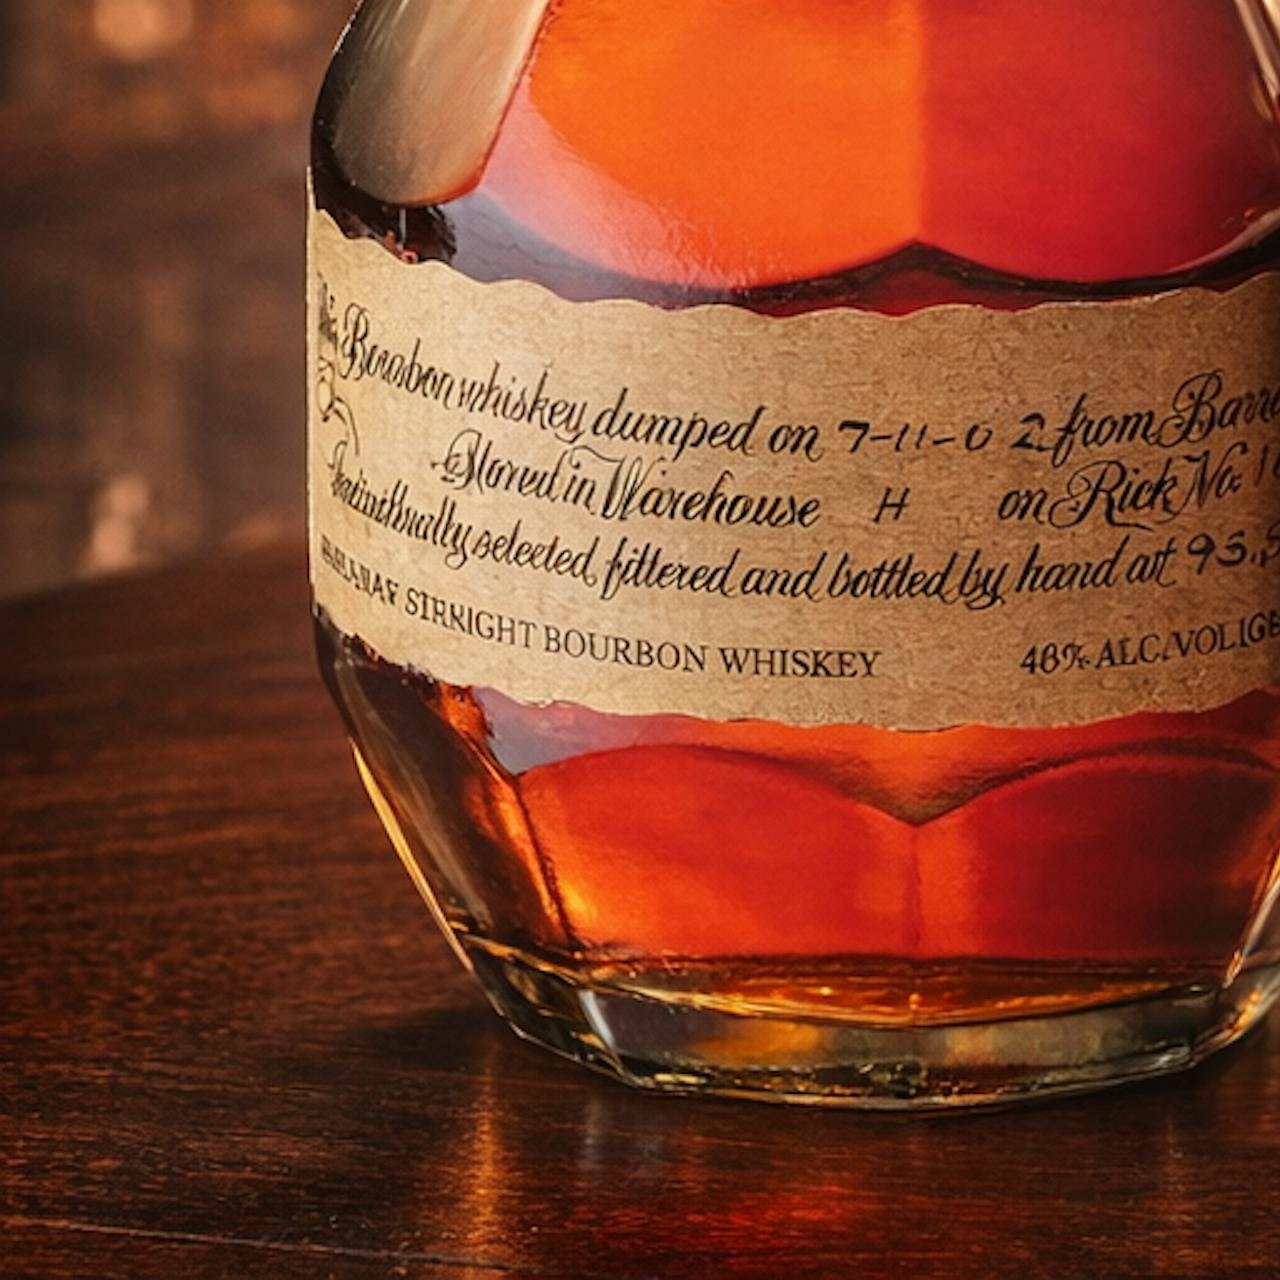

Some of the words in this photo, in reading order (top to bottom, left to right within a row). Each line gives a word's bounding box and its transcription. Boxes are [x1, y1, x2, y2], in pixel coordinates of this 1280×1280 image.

[591, 387, 765, 463] dumped
[768, 423, 823, 462] on
[1048, 393, 1160, 469] from
[590, 455, 821, 528] Warehouse
[874, 486, 911, 524] H
[998, 485, 1049, 522] on
[1048, 458, 1178, 532] Rick
[600, 535, 740, 601] filtered
[740, 550, 828, 604] and
[828, 551, 962, 607] bottled
[958, 548, 1011, 611] by
[1014, 534, 1131, 595] hand
[1126, 536, 1178, 588] at
[544, 628, 710, 673] BOURBON
[717, 645, 882, 679] WHISKEY
